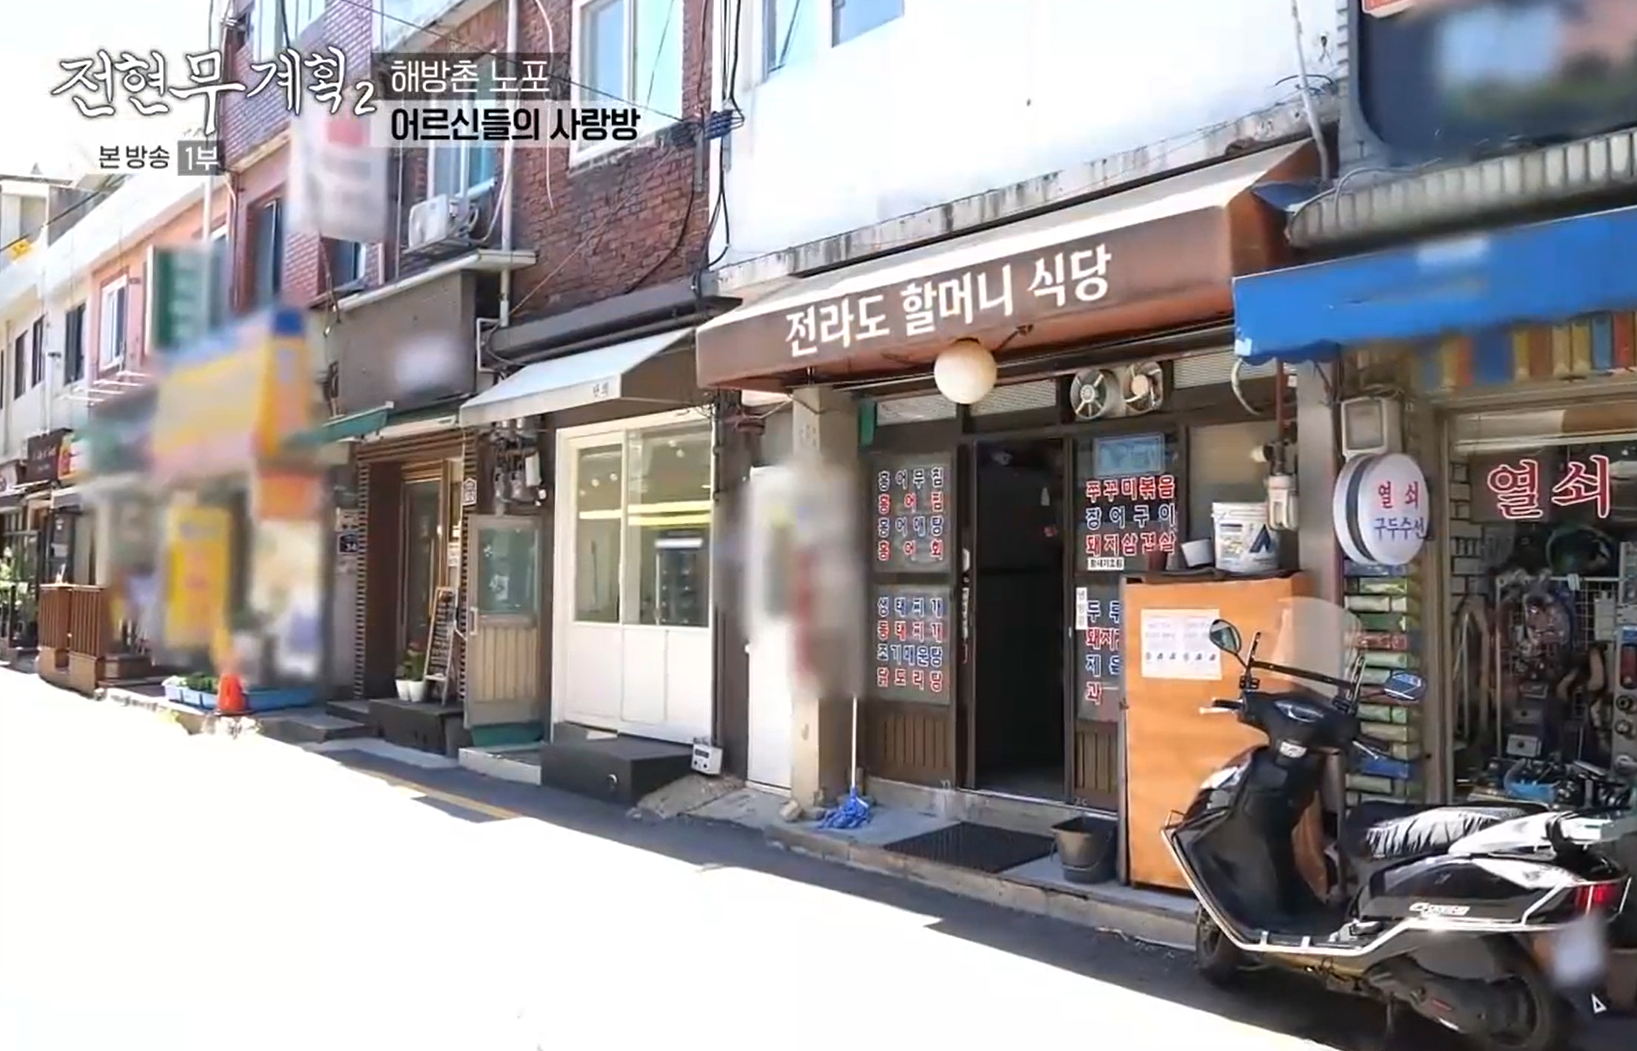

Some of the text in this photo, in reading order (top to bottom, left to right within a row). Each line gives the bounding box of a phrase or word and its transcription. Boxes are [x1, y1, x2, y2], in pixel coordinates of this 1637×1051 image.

[784, 244, 1112, 358] 전라도 할머니 식당
[1377, 480, 1420, 510] 열쇠
[1487, 454, 1611, 520] 열쇠
[1085, 502, 1176, 530] 장어구이
[1374, 516, 1428, 541] 구두수선
[877, 643, 943, 668] 조기매운탕
[877, 667, 943, 692] 닭도리탕
